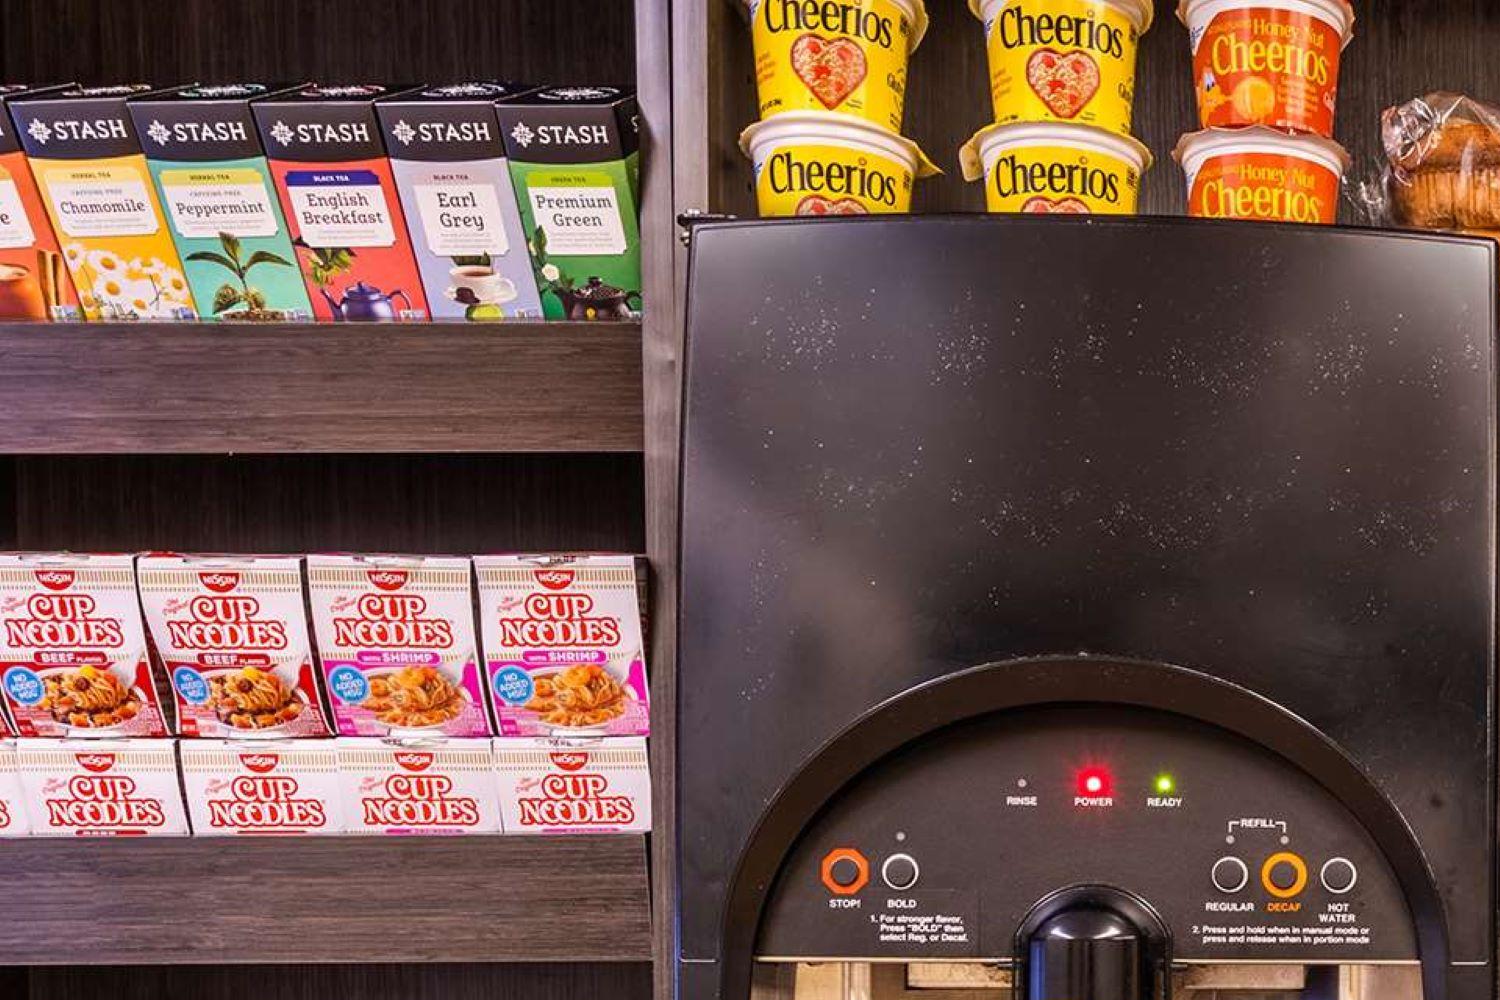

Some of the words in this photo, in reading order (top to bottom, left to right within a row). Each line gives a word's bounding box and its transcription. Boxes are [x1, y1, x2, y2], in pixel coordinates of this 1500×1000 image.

[765, 0, 892, 48] Cheerios
[1000, 6, 1123, 59] Cheerios
[1253, 18, 1299, 39] Honey
[1211, 32, 1328, 86] Cheerios
[55, 119, 128, 141] STASH
[173, 123, 248, 142] STASH
[299, 123, 370, 143] STASH
[420, 122, 491, 142] STASH
[538, 125, 610, 145] STASH
[334, 174, 350, 182] TEA
[769, 152, 897, 207] Cheerios
[995, 153, 1120, 207] Cheerios
[1239, 163, 1286, 186] Honey
[1292, 167, 1316, 189] Nut
[60, 198, 146, 214] Chamomile
[176, 201, 266, 219] Peppermint
[308, 192, 369, 210] English
[438, 192, 477, 209] Earl
[536, 194, 613, 210] Premium
[1202, 178, 1321, 223] Cheerios
[302, 210, 384, 226] Breakfast
[440, 211, 485, 232] Grey
[553, 212, 602, 228] Green
[28, 593, 95, 620] CUP
[190, 595, 259, 622] CUP
[359, 593, 426, 620] CUP
[525, 593, 593, 620] CUP
[5, 618, 124, 648] NOODLES
[168, 620, 288, 650] NOODLES
[334, 618, 454, 648] NOODLES
[500, 618, 621, 648] NOODLES
[41, 652, 75, 663] BEEF
[203, 654, 237, 665] BEEF
[382, 652, 433, 662] SHRIMP
[549, 652, 600, 662] SHRIMP
[70, 775, 136, 801] CUP
[231, 776, 298, 802] CUP
[386, 774, 452, 801] CUP
[542, 774, 607, 800] CUP
[1006, 795, 1037, 806] RINSE
[1074, 797, 1113, 807] POWER
[1147, 797, 1183, 807] READY
[47, 799, 165, 827] NOODLES
[208, 799, 327, 827] NOODLES
[363, 797, 480, 826] NOODLES
[518, 796, 635, 826] NOODLES
[1240, 818, 1276, 828] REFILL
[828, 899, 862, 909] STOP!
[887, 899, 917, 909] BOLD
[1205, 902, 1255, 912] REGULAR
[1267, 902, 1302, 912] DECAF
[1328, 903, 1350, 912] HOT
[880, 914, 894, 923] For
[897, 914, 934, 926] stronger
[1318, 913, 1356, 923] WATER
[880, 924, 906, 933] Press
[944, 924, 965, 933] then
[880, 933, 907, 942] select
[929, 934, 940, 942] or
[1191, 925, 1201, 934] 2.
[1202, 926, 1227, 935] Press
[1228, 926, 1245, 935] and
[1246, 926, 1266, 935] hold
[1267, 926, 1291, 935] when
[1292, 926, 1300, 935] in
[1302, 926, 1333, 935] manual
[1334, 926, 1360, 935] mode
[1361, 926, 1371, 935] or
[1202, 935, 1227, 945] press
[1228, 935, 1245, 944] and
[1246, 935, 1277, 944] release
[1278, 935, 1302, 944] when
[1303, 935, 1311, 944] in
[1313, 935, 1343, 945] portion
[1344, 935, 1370, 944] mode
